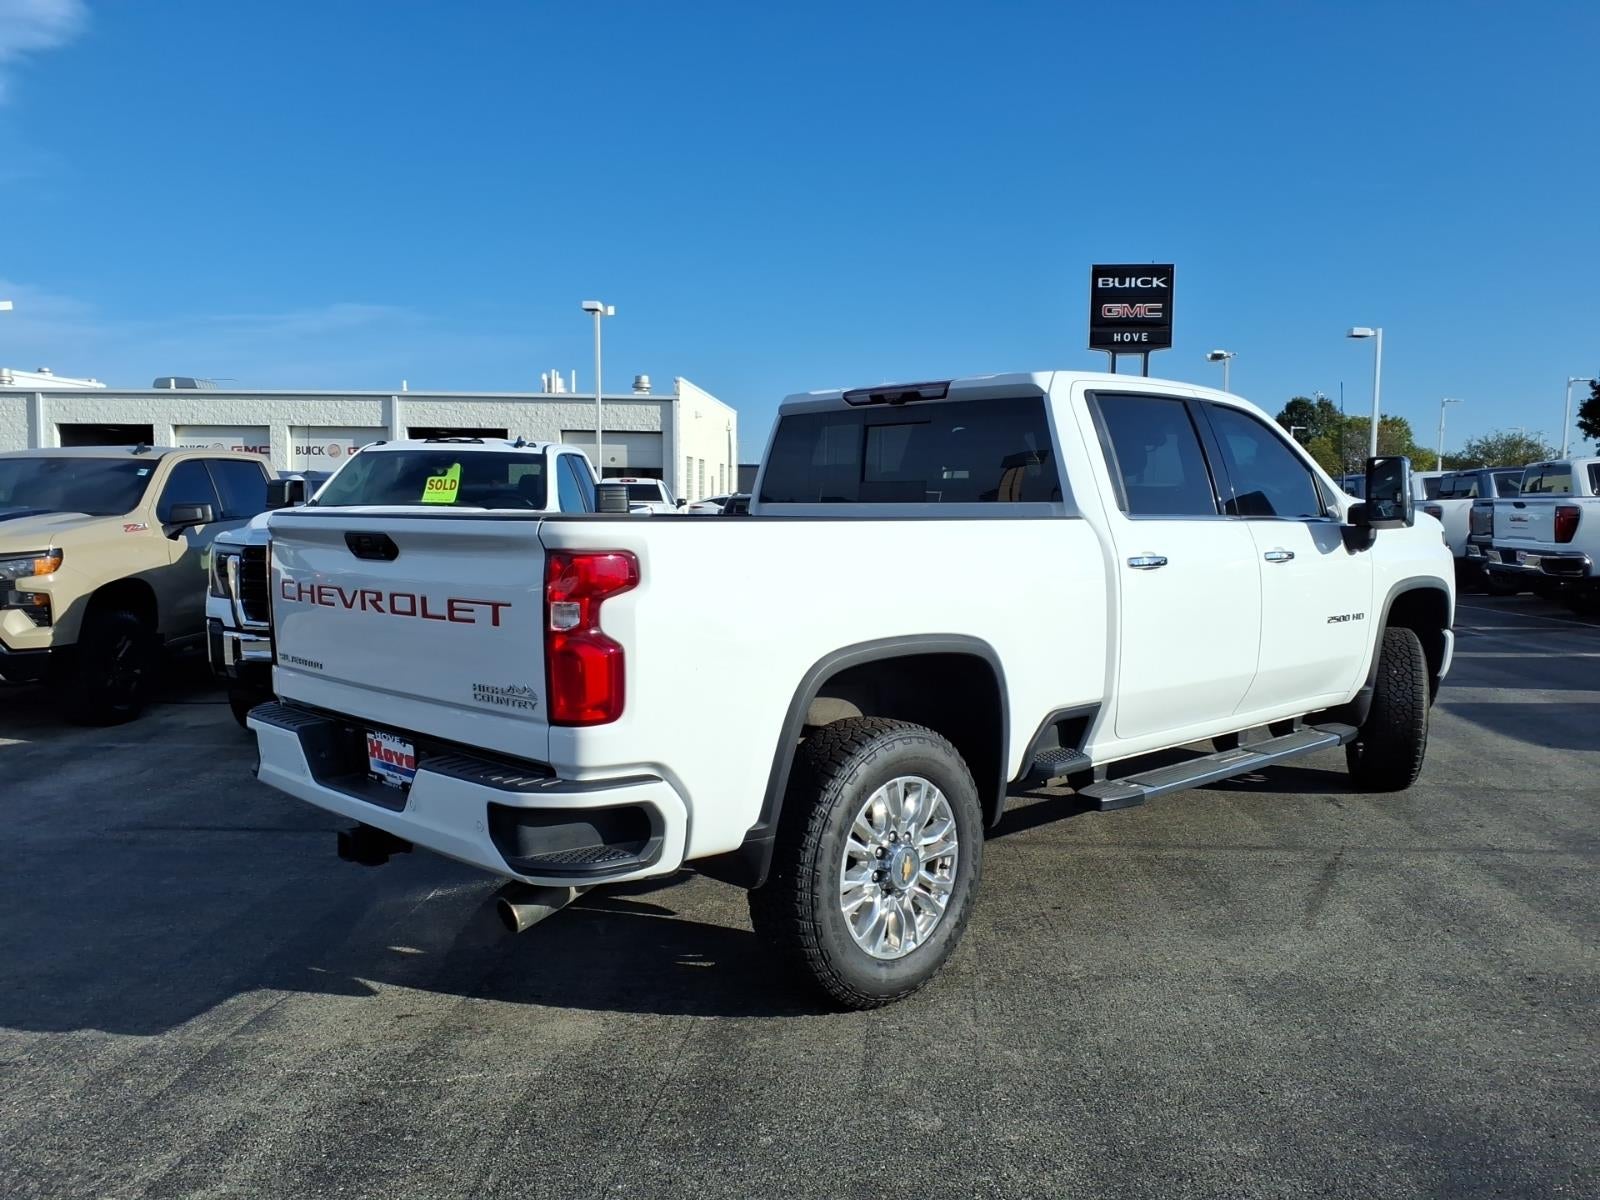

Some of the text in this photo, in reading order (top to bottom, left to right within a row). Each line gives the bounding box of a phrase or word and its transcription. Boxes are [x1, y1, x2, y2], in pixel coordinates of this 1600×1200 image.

[1097, 276, 1168, 288] BUICK
[1102, 303, 1163, 318] GMC
[1113, 332, 1149, 342] HOVE
[295, 446, 325, 456] BUICK
[427, 478, 457, 491] SOLD
[281, 578, 512, 627] CHEVROLET
[1327, 612, 1365, 624] 2500 HD
[472, 693, 538, 711] COUNTRY
